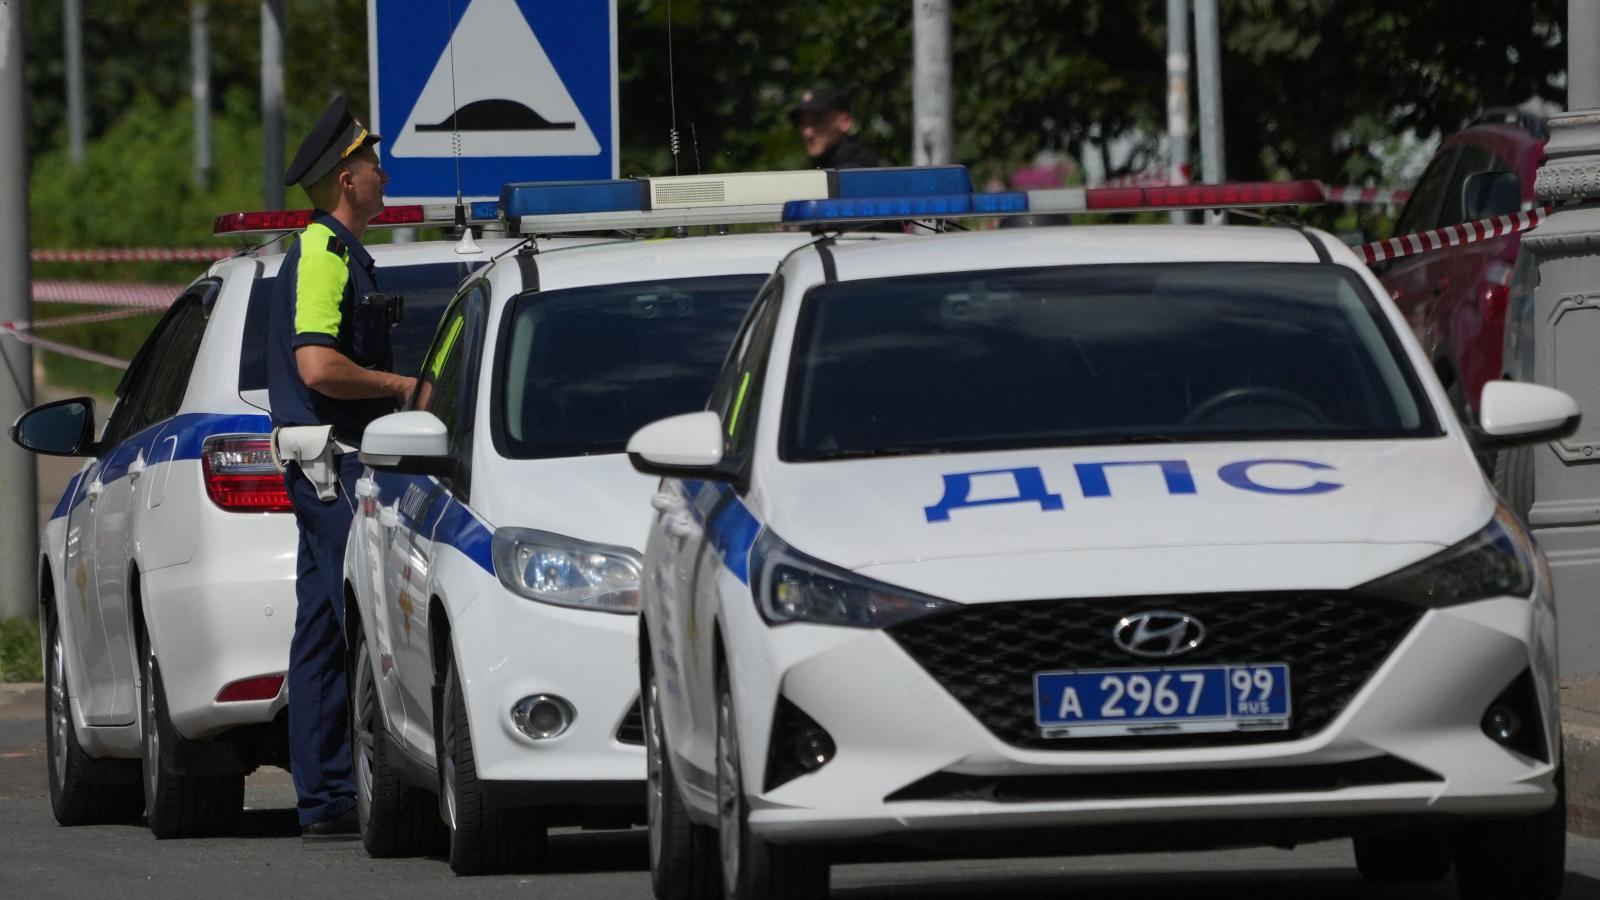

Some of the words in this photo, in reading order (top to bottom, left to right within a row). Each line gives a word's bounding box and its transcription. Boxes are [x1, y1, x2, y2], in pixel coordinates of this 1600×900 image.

[924, 459, 1345, 523] ДПС
[1100, 674, 1204, 717] 2967
[1232, 669, 1273, 701] 99
[1239, 702, 1270, 713] RUS
